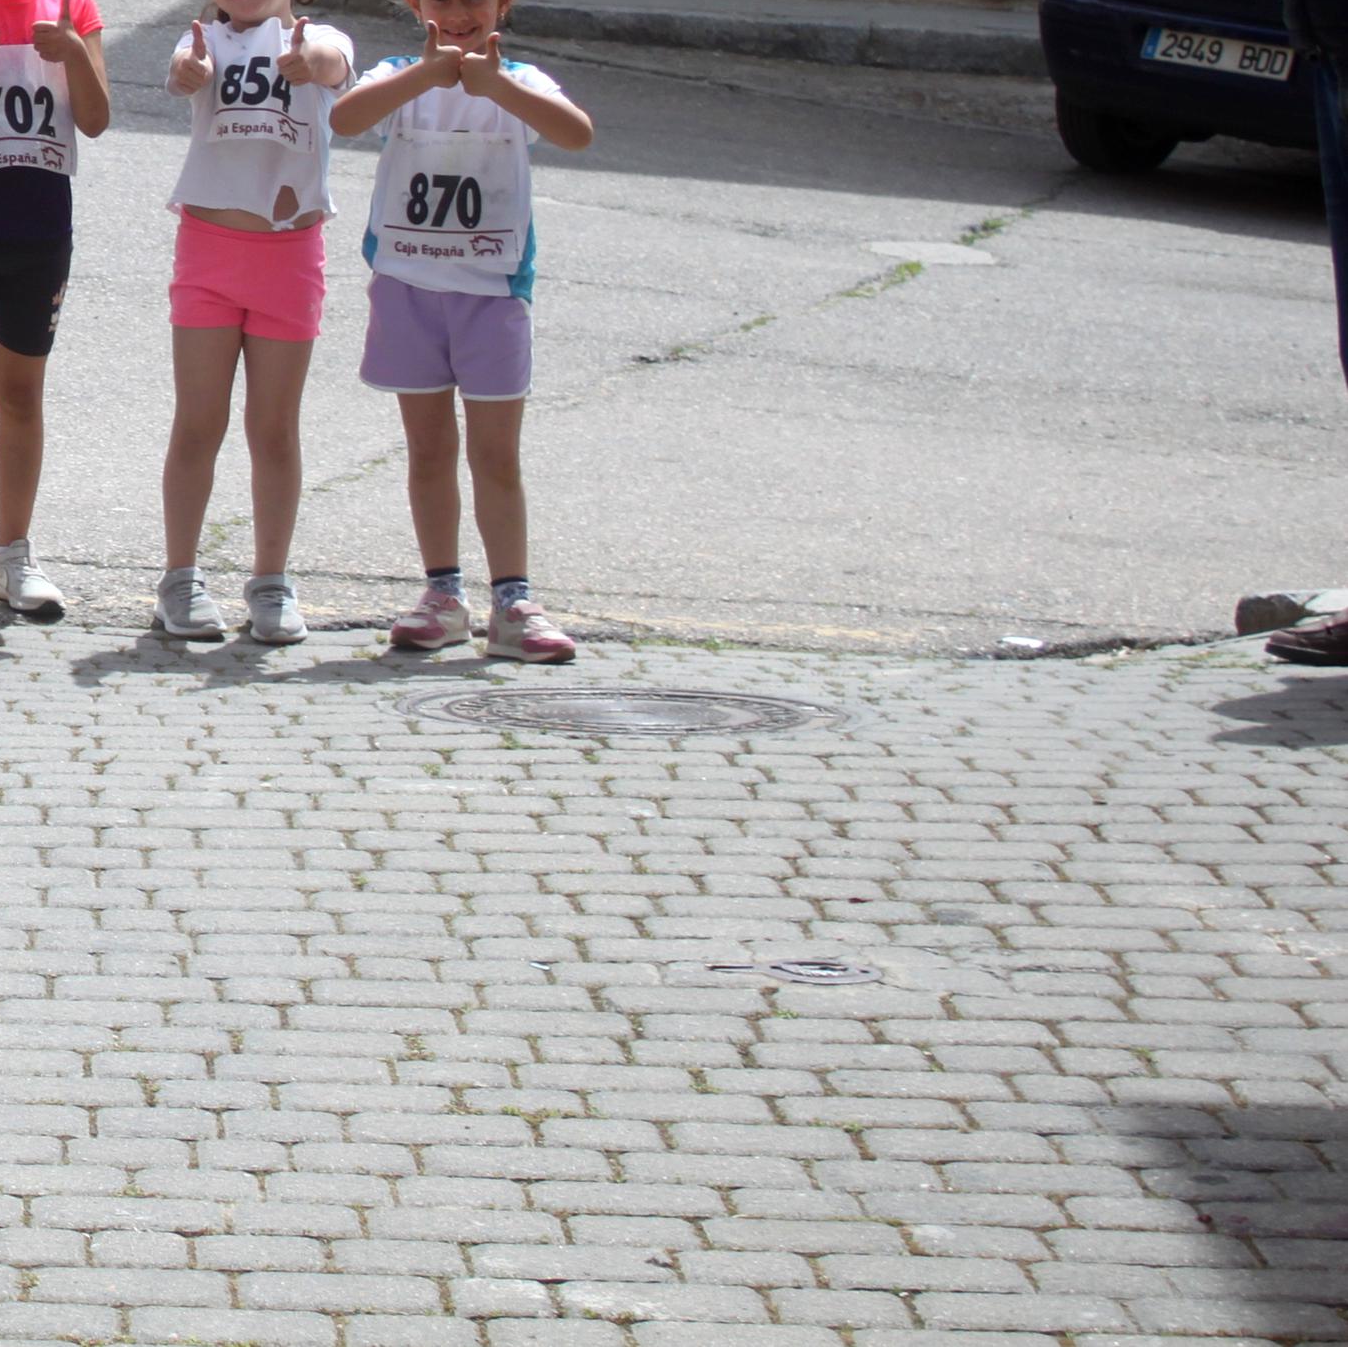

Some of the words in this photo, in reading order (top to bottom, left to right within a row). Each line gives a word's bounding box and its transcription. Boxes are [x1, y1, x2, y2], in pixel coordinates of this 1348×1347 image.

[1160, 31, 1223, 65] 2949
[220, 56, 292, 114] 854
[232, 122, 274, 136] España
[406, 172, 482, 230] 870
[394, 240, 418, 257] Caja
[421, 243, 465, 259] España
